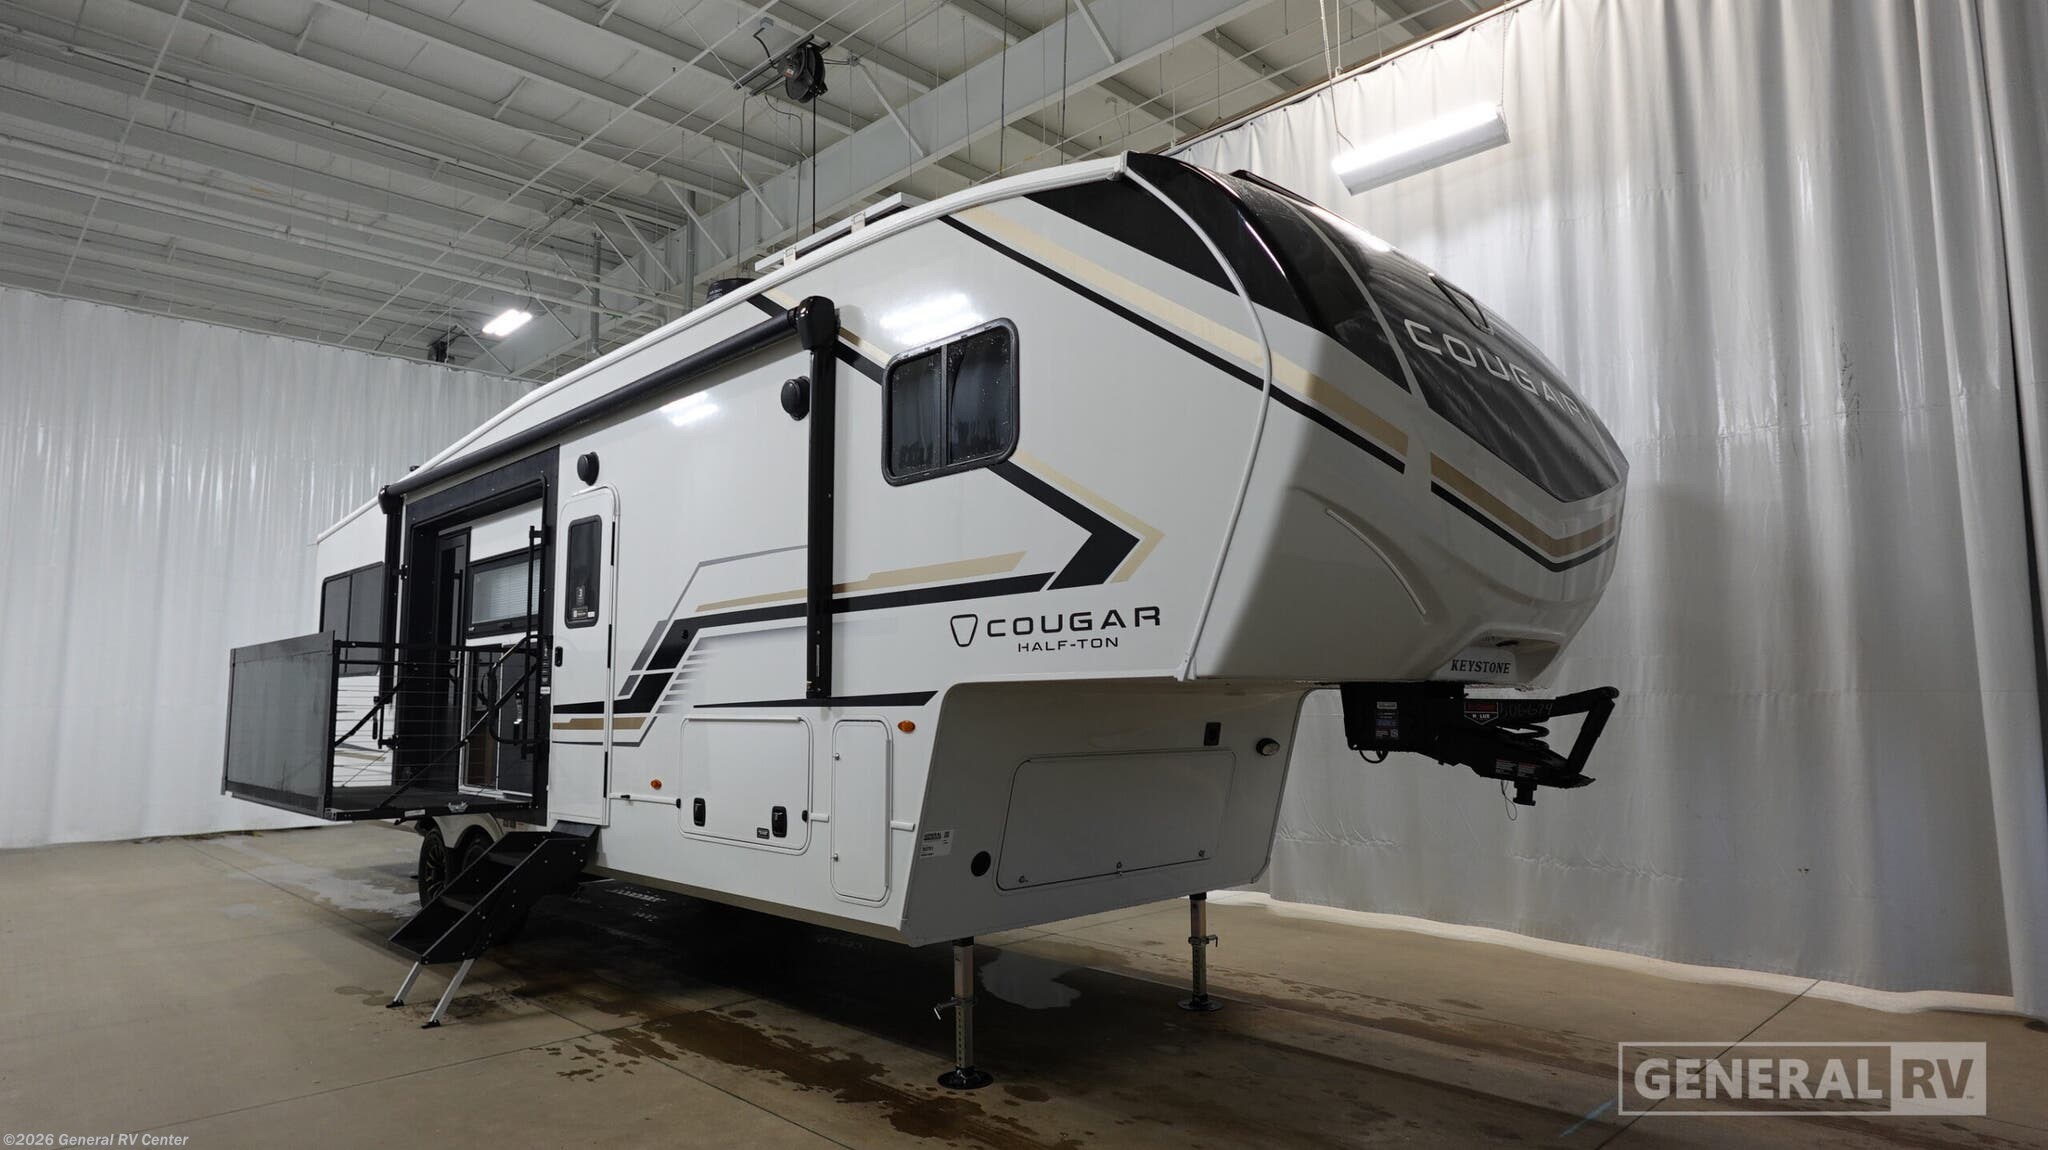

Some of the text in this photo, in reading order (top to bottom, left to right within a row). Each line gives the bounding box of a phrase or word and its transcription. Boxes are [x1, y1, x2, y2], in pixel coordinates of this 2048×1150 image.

[1403, 318, 1589, 424] COUGAR
[986, 605, 1161, 638] COUGAR
[1017, 636, 1119, 653] HALF-TON
[1450, 658, 1511, 674] KEYSTONE
